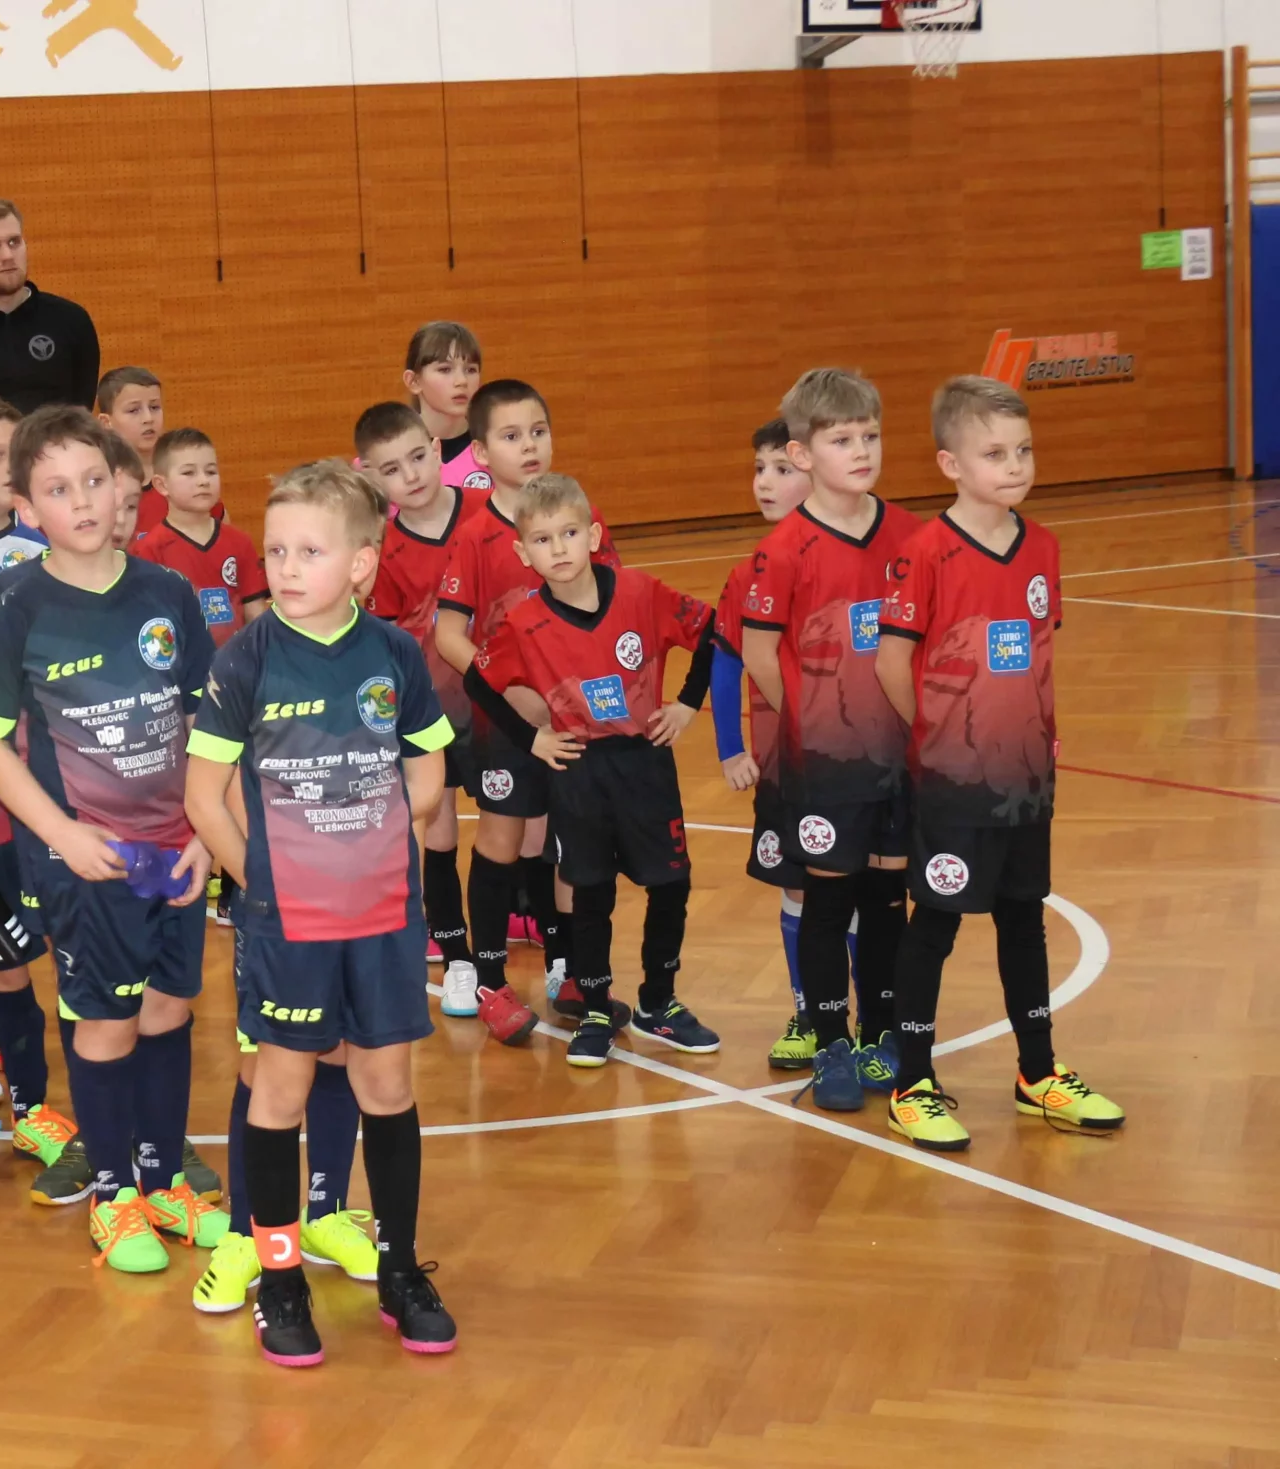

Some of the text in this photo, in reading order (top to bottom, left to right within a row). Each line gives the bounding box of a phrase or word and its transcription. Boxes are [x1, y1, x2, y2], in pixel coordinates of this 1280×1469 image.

[1026, 354, 1135, 382] GRADITELJSTVO
[861, 612, 879, 623] EUR
[859, 622, 879, 639] Spi
[999, 632, 1021, 643] EURO
[996, 641, 1023, 660] Spin
[46, 653, 104, 682] Zeus
[593, 685, 615, 697] EURO
[61, 696, 136, 717] FORTIS TIM
[262, 699, 325, 722] Zeus
[593, 694, 620, 712] Spin
[81, 711, 130, 727] PLEŠKOVEC
[260, 757, 314, 769] FORTIS
[347, 751, 379, 766] Pilana
[123, 763, 167, 779] PLEŠKOVEC
[278, 769, 331, 781] PLEŠKOVEC
[360, 785, 392, 800] ČAKOVEC
[313, 819, 368, 834] PLEŠKOVEC
[669, 818, 686, 854] 5
[433, 926, 466, 939] alpas
[260, 999, 323, 1023] Zeus
[1027, 1005, 1050, 1019] alp
